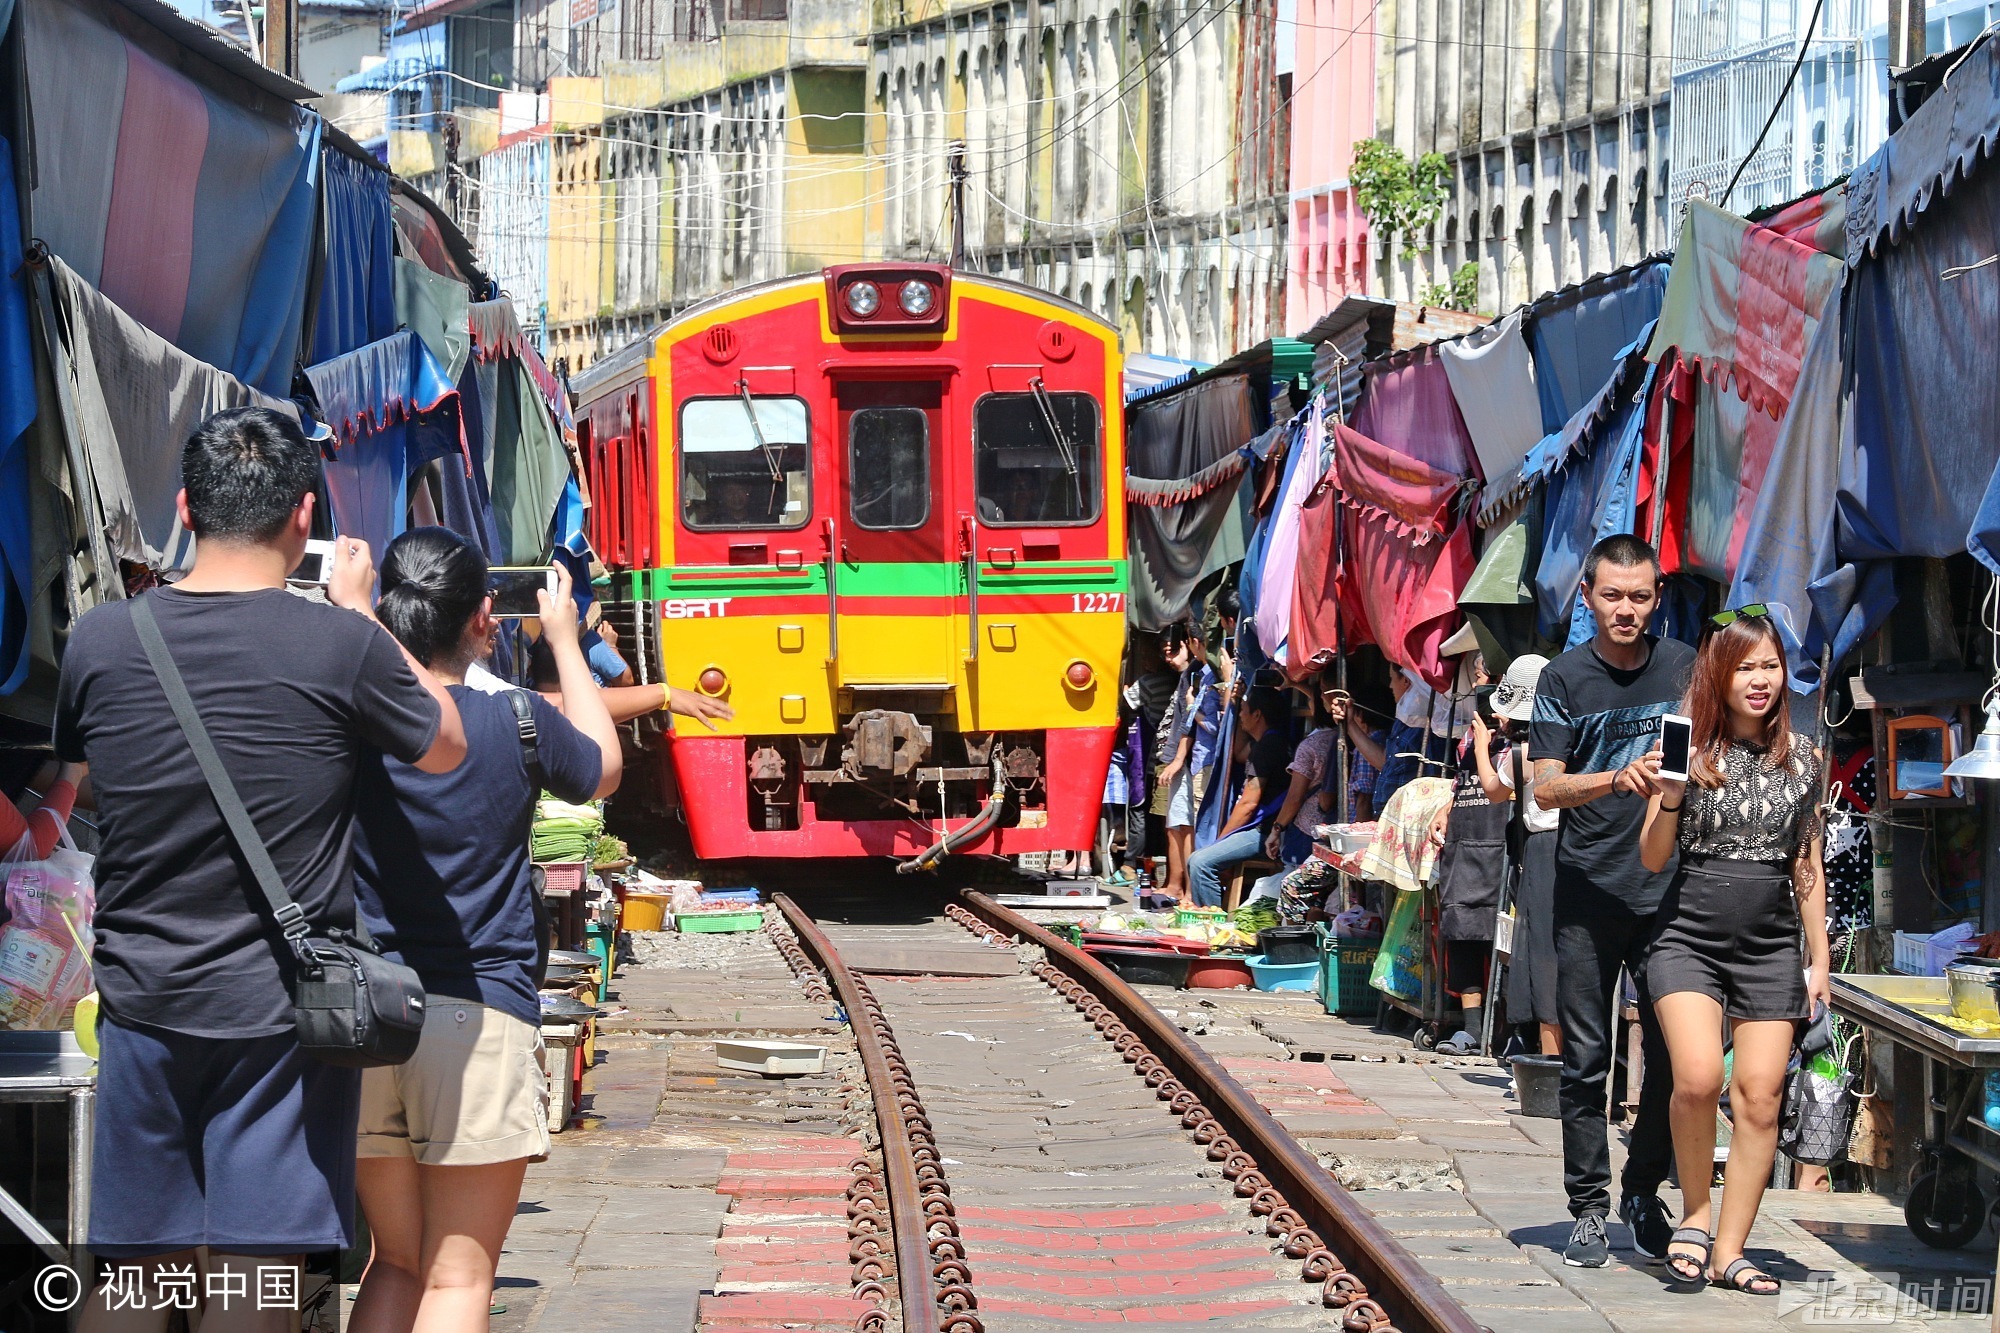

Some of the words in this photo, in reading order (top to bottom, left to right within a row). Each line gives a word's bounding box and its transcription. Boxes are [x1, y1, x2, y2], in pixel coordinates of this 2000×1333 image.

[665, 598, 732, 618] SRT
[1072, 593, 1121, 612] 1227
[1618, 721, 1638, 736] PAIN
[1639, 719, 1654, 734] NO
